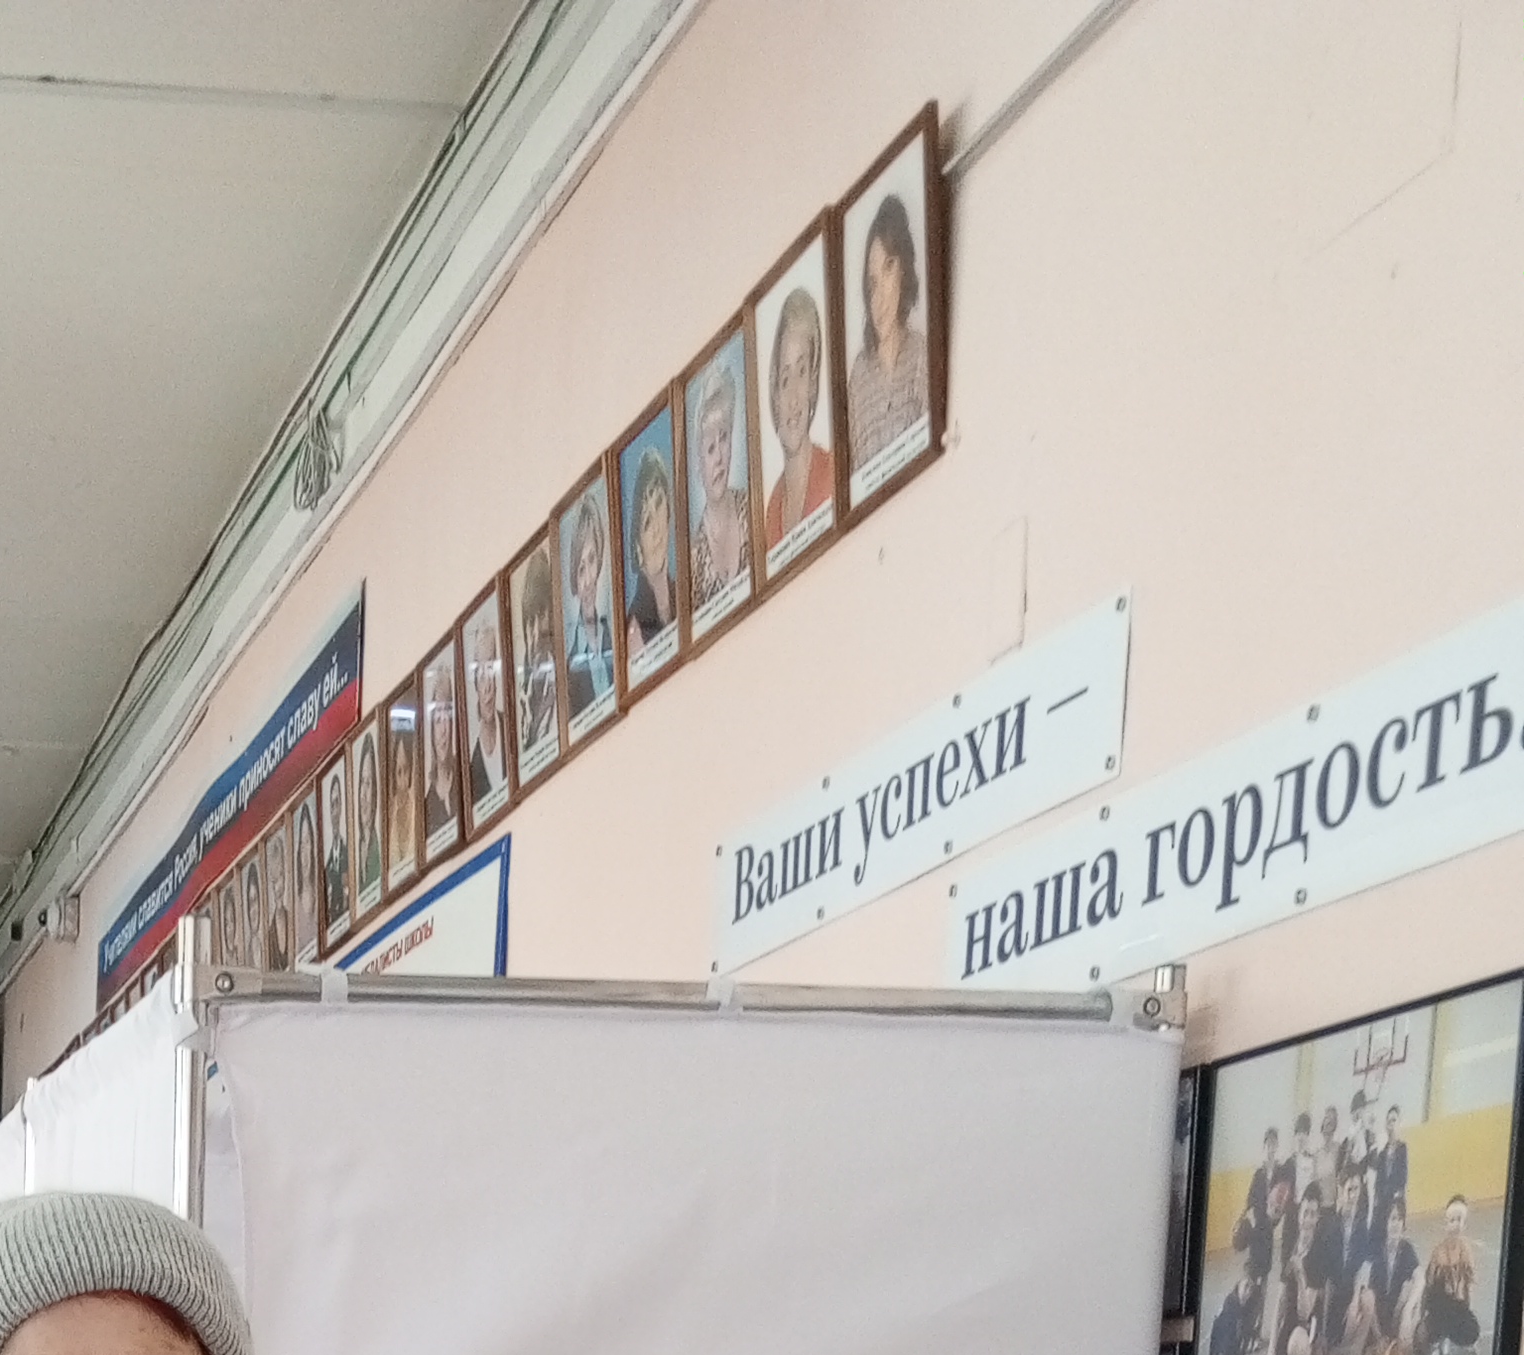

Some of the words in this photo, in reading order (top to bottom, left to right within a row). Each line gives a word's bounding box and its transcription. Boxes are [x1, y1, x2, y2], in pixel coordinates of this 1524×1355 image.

[138, 871, 173, 930] славится
[199, 786, 237, 862] ученики
[238, 725, 286, 812] приносят
[286, 682, 322, 731] славу
[732, 806, 843, 926] Ваши
[853, 694, 1033, 887] успехи
[960, 848, 1125, 981] наша
[1139, 672, 1524, 914] гордость
